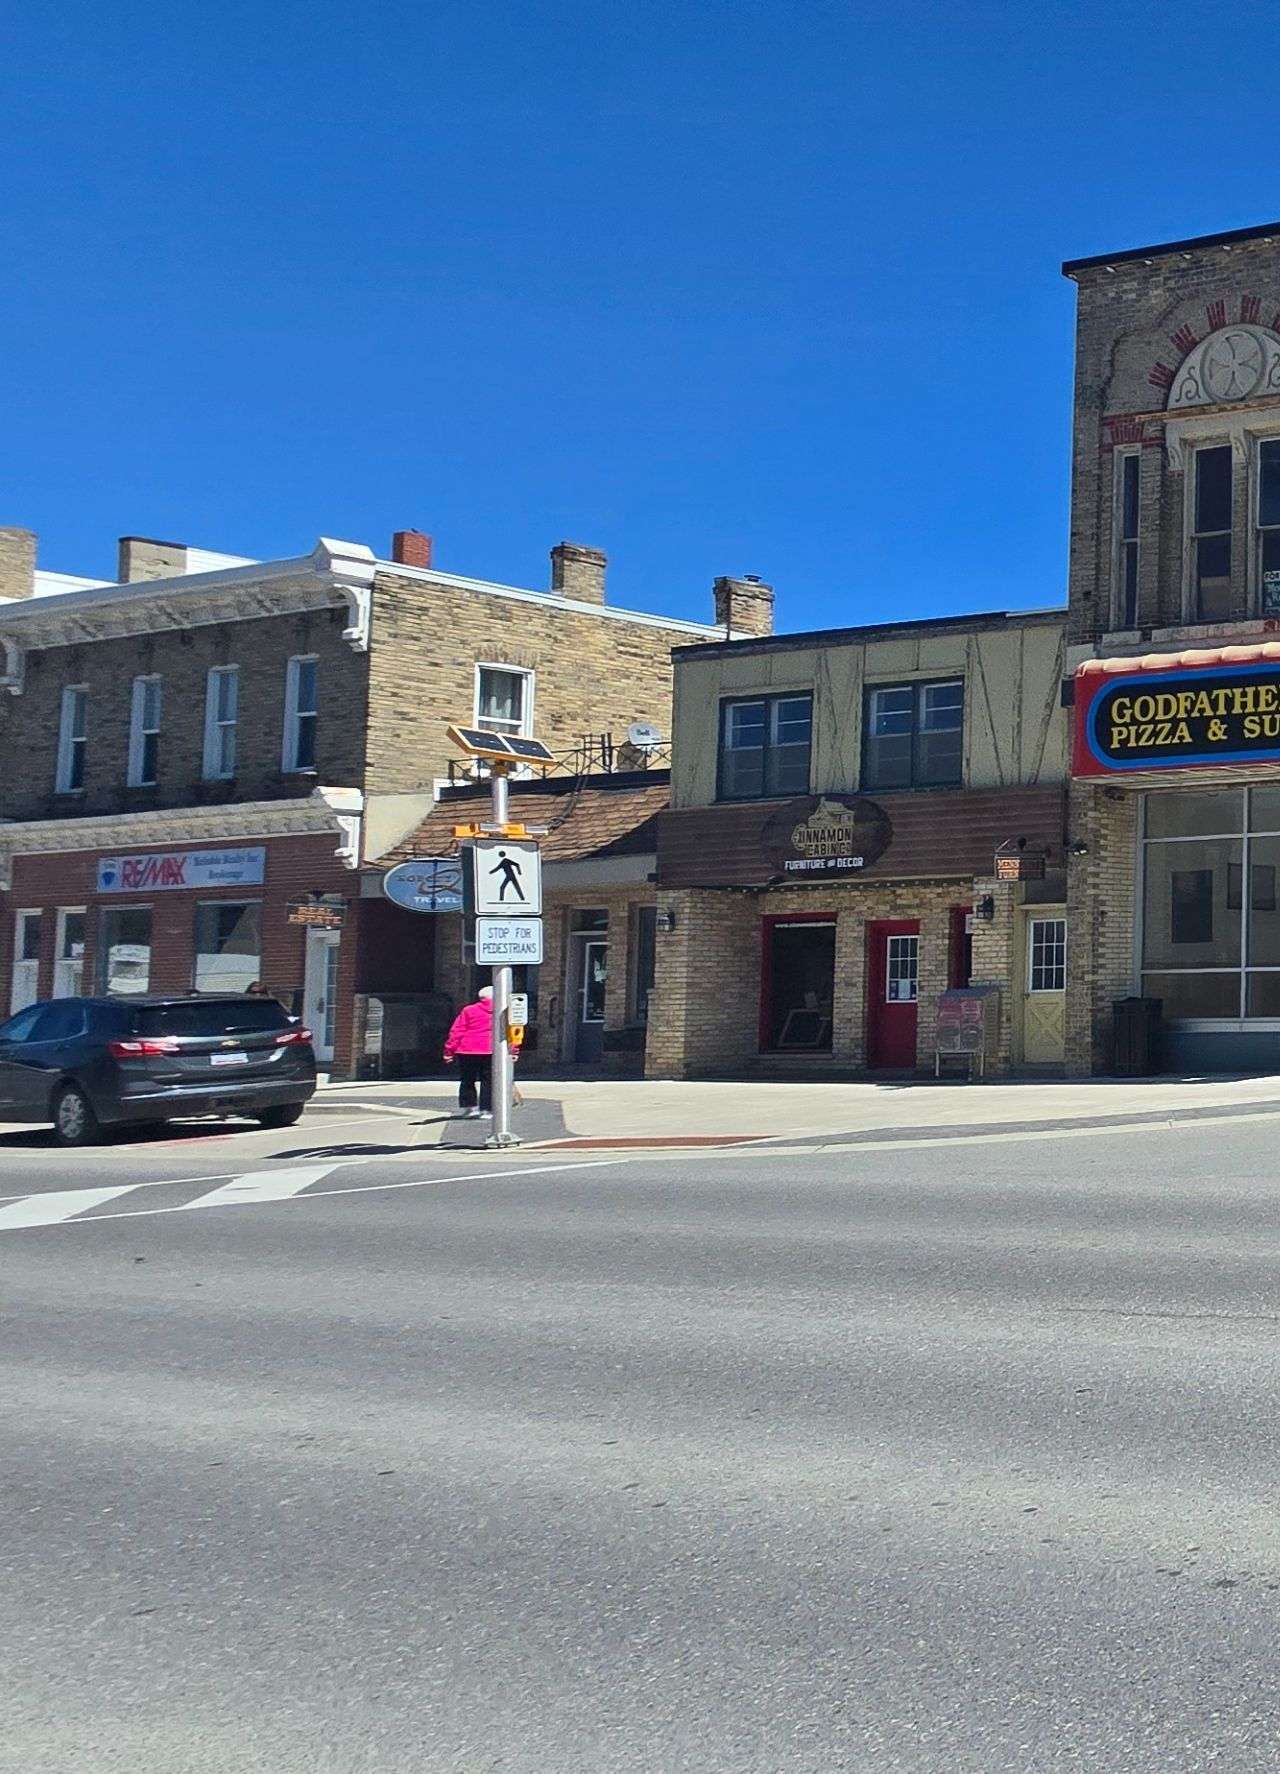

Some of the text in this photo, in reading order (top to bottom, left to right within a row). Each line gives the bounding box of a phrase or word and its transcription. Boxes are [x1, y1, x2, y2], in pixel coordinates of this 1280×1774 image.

[1109, 722, 1193, 749] PIZZA
[1207, 718, 1228, 741] &
[784, 859, 827, 870] FURNITURE
[836, 856, 864, 868] DECOR
[121, 856, 187, 888] RE/MAX
[487, 927, 532, 939] STOP FOR
[482, 942, 537, 954] PEDESTRIANS
